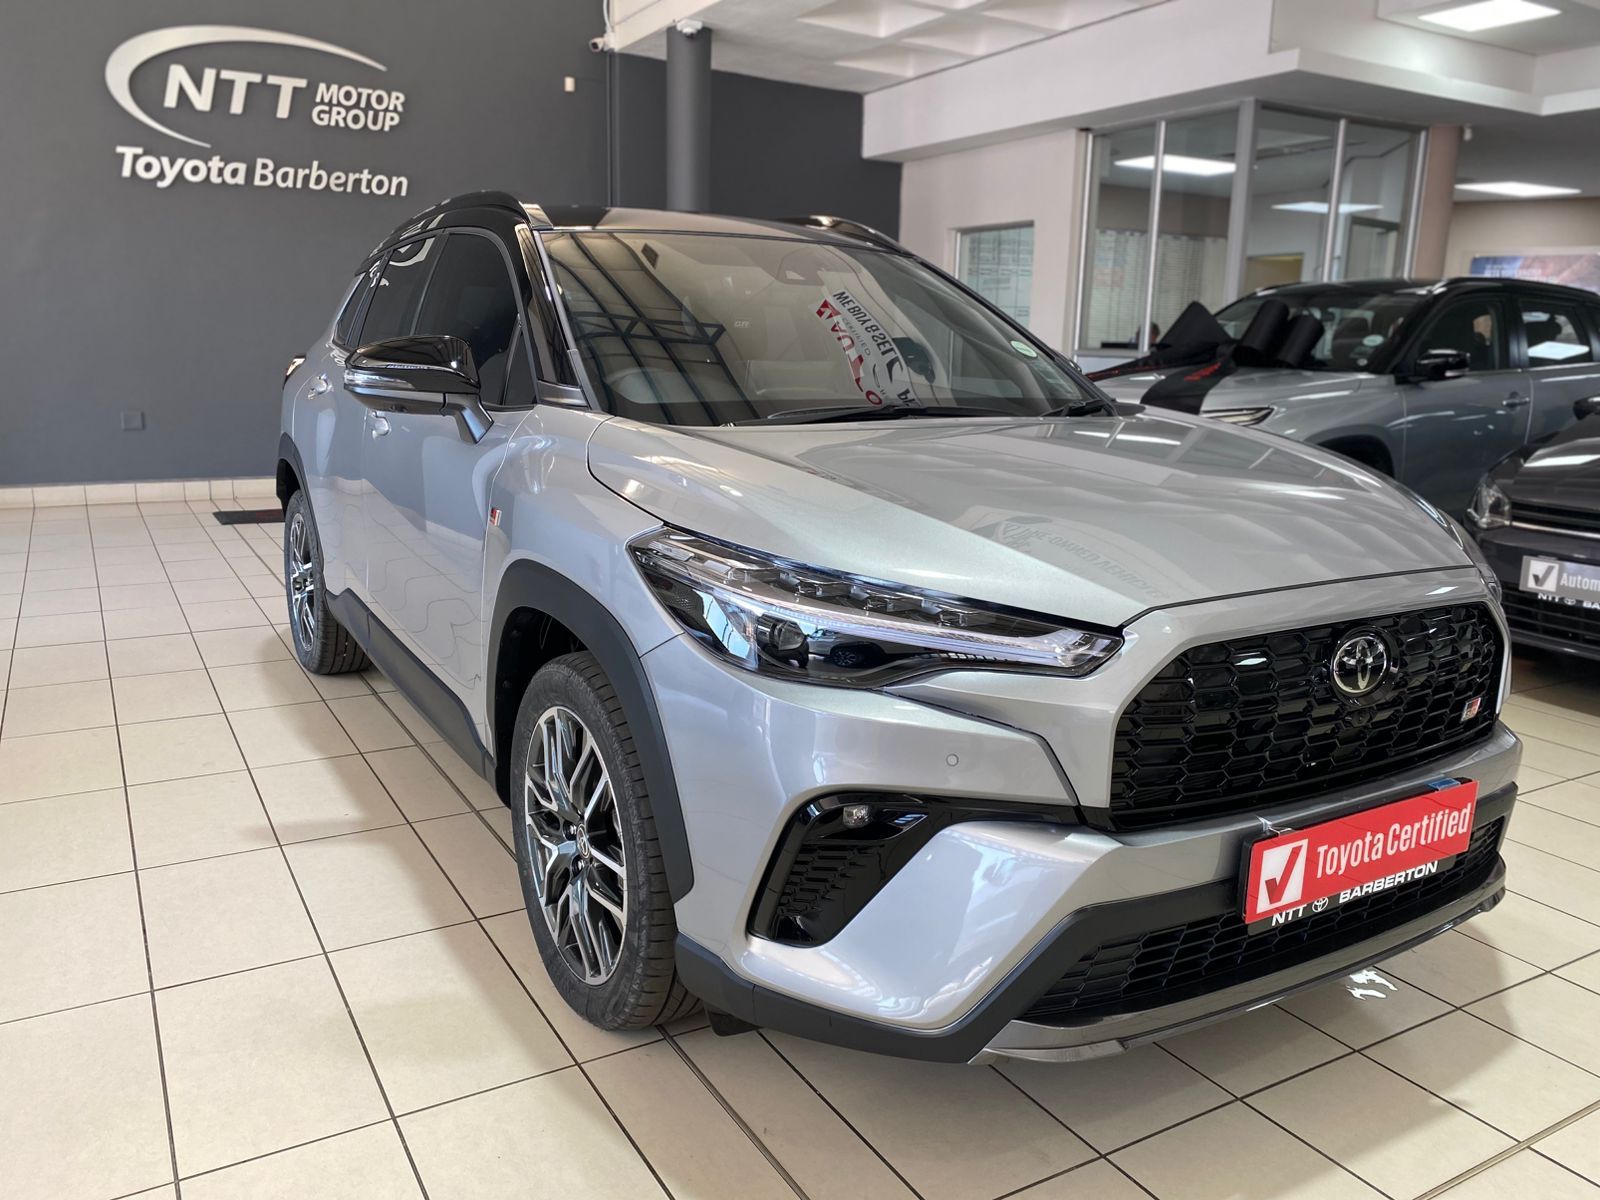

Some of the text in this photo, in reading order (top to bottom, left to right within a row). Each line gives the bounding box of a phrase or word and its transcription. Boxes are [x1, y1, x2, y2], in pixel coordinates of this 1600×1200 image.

[163, 63, 308, 119] NTT
[315, 82, 406, 112] MOTOR
[311, 105, 401, 132] GROUP
[115, 145, 409, 197] Toyota Barberton
[1316, 802, 1471, 879] Toyota Certified
[1271, 860, 1438, 927] NTT BARBERTON
